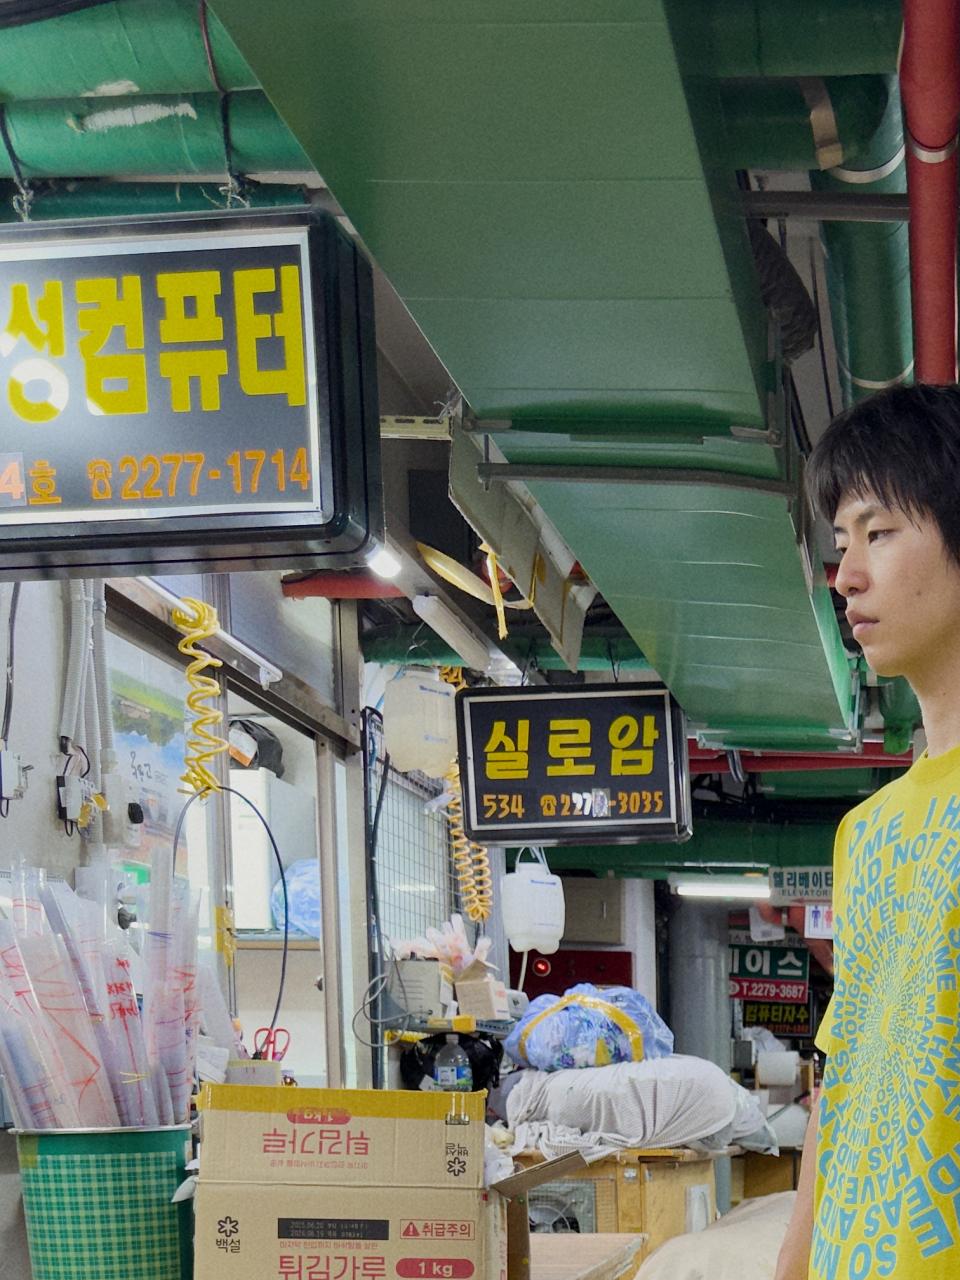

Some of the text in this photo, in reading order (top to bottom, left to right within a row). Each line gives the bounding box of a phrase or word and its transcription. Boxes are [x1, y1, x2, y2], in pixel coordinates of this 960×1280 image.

[119, 447, 311, 500] 2277-1714
[484, 715, 660, 780] 실로암
[482, 793, 525, 819] 534
[892, 831, 942, 870] NOT
[782, 888, 828, 897] ELEVATOR
[262, 1127, 371, 1156] 튀김가루
[422, 1222, 471, 1238] 취급주의
[215, 1238, 241, 1253] 백설
[418, 1262, 426, 1275] 1
[432, 1262, 454, 1277] kg
